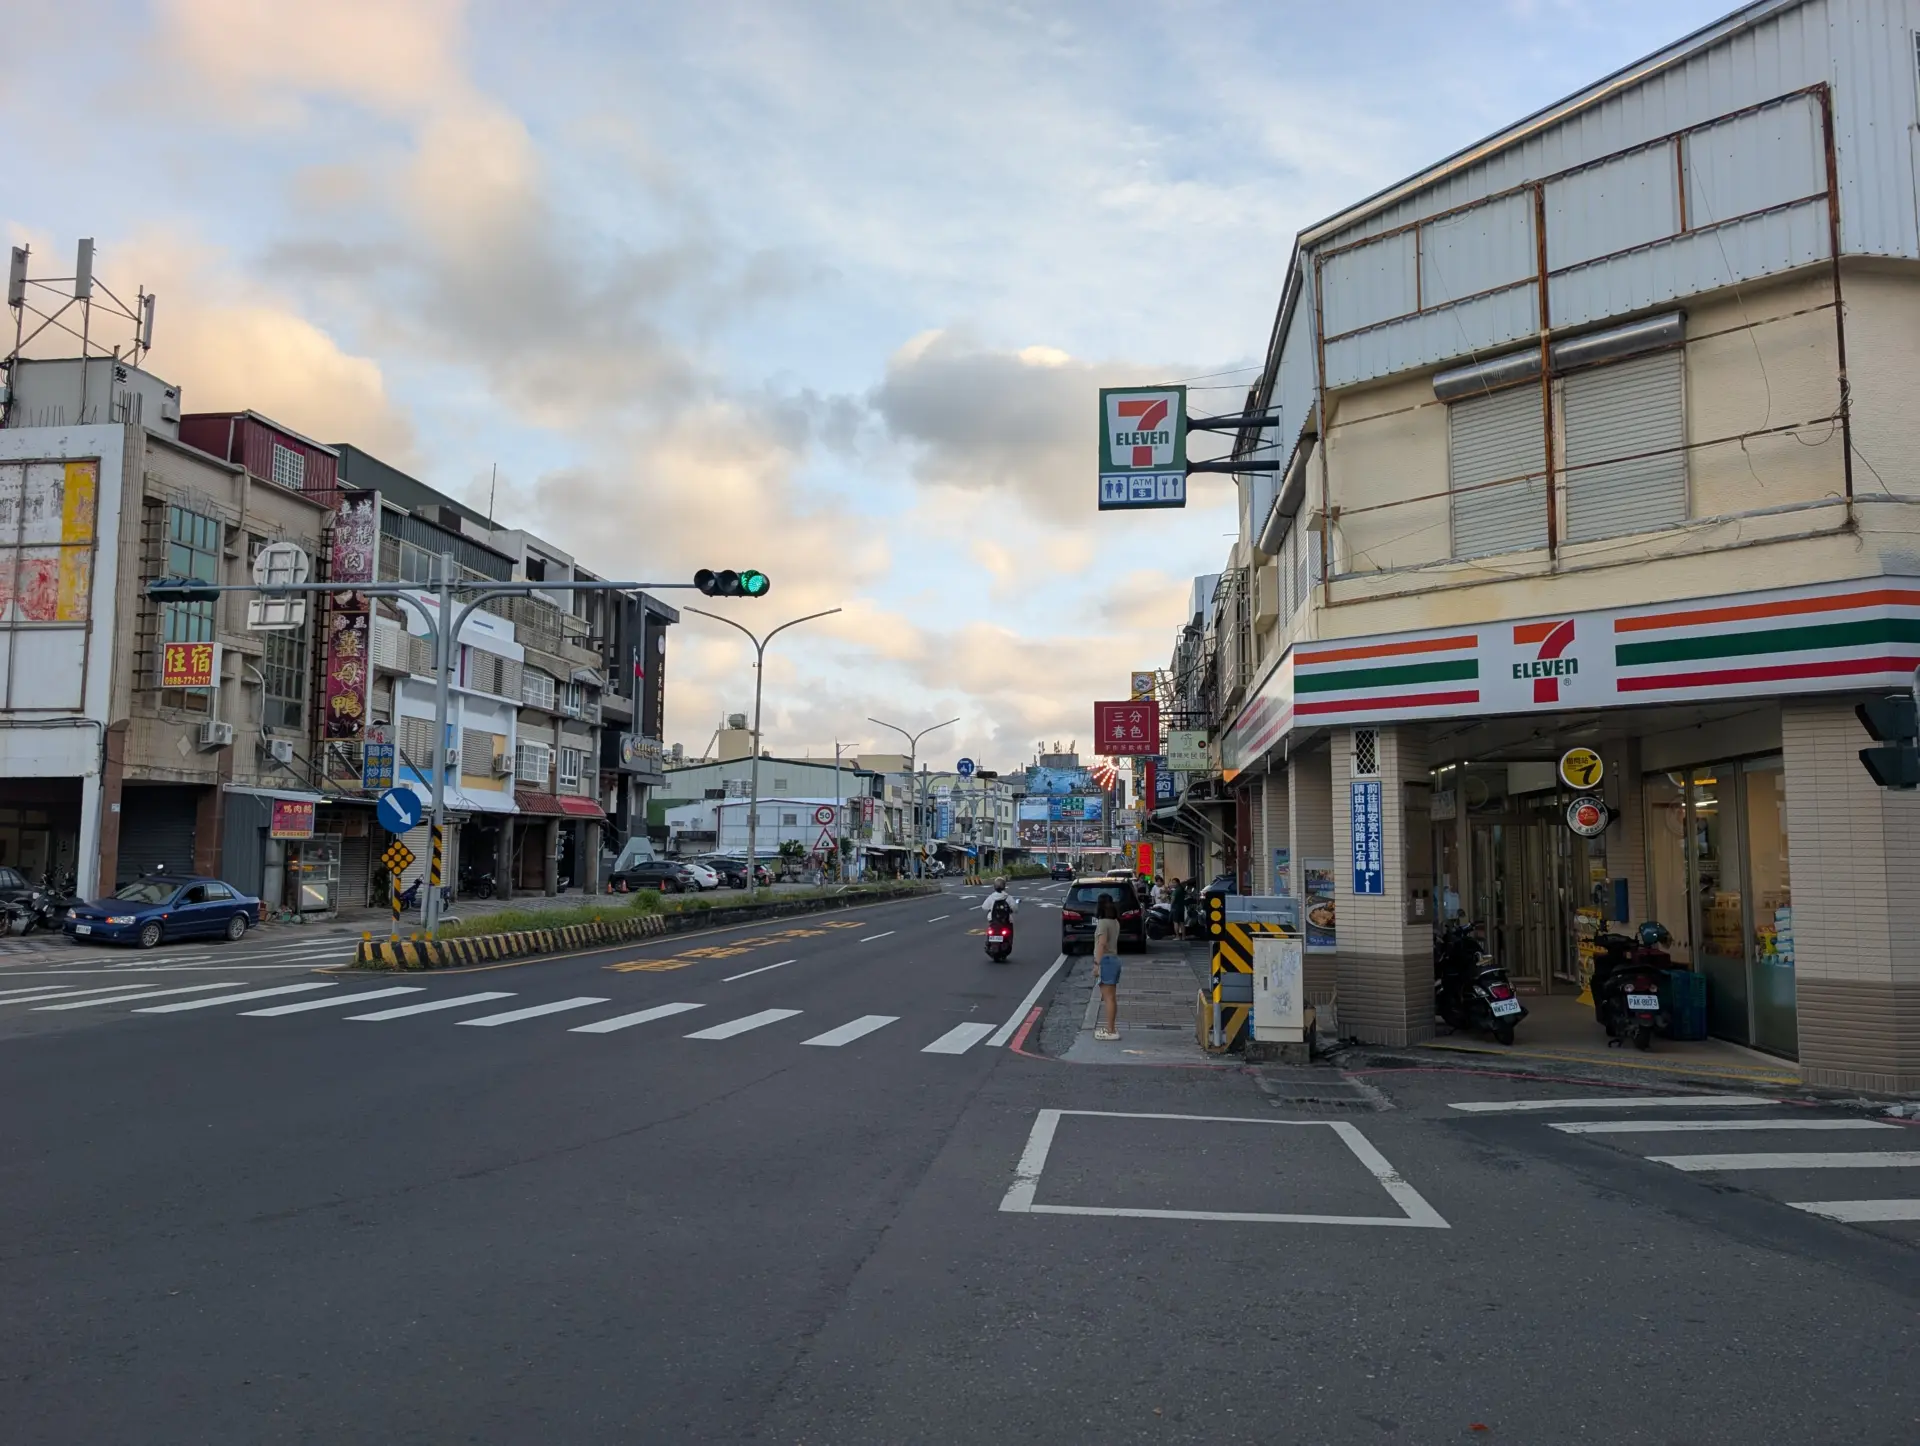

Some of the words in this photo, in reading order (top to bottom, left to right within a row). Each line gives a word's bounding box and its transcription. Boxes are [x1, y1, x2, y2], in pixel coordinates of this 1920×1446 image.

[1118, 399, 1168, 467] 7
[1132, 478, 1152, 486] ATM
[344, 553, 365, 572] 肉
[166, 645, 212, 674] 住宿
[331, 629, 364, 719] 薑母鴨
[1513, 618, 1576, 704] 7
[1112, 710, 1143, 724] 三分
[1112, 725, 1144, 739] 春色
[819, 811, 831, 820] 50
[1354, 784, 1367, 871] 請由加油站路口右轉
[1367, 783, 1380, 871] 前往福安宮大型車輛
